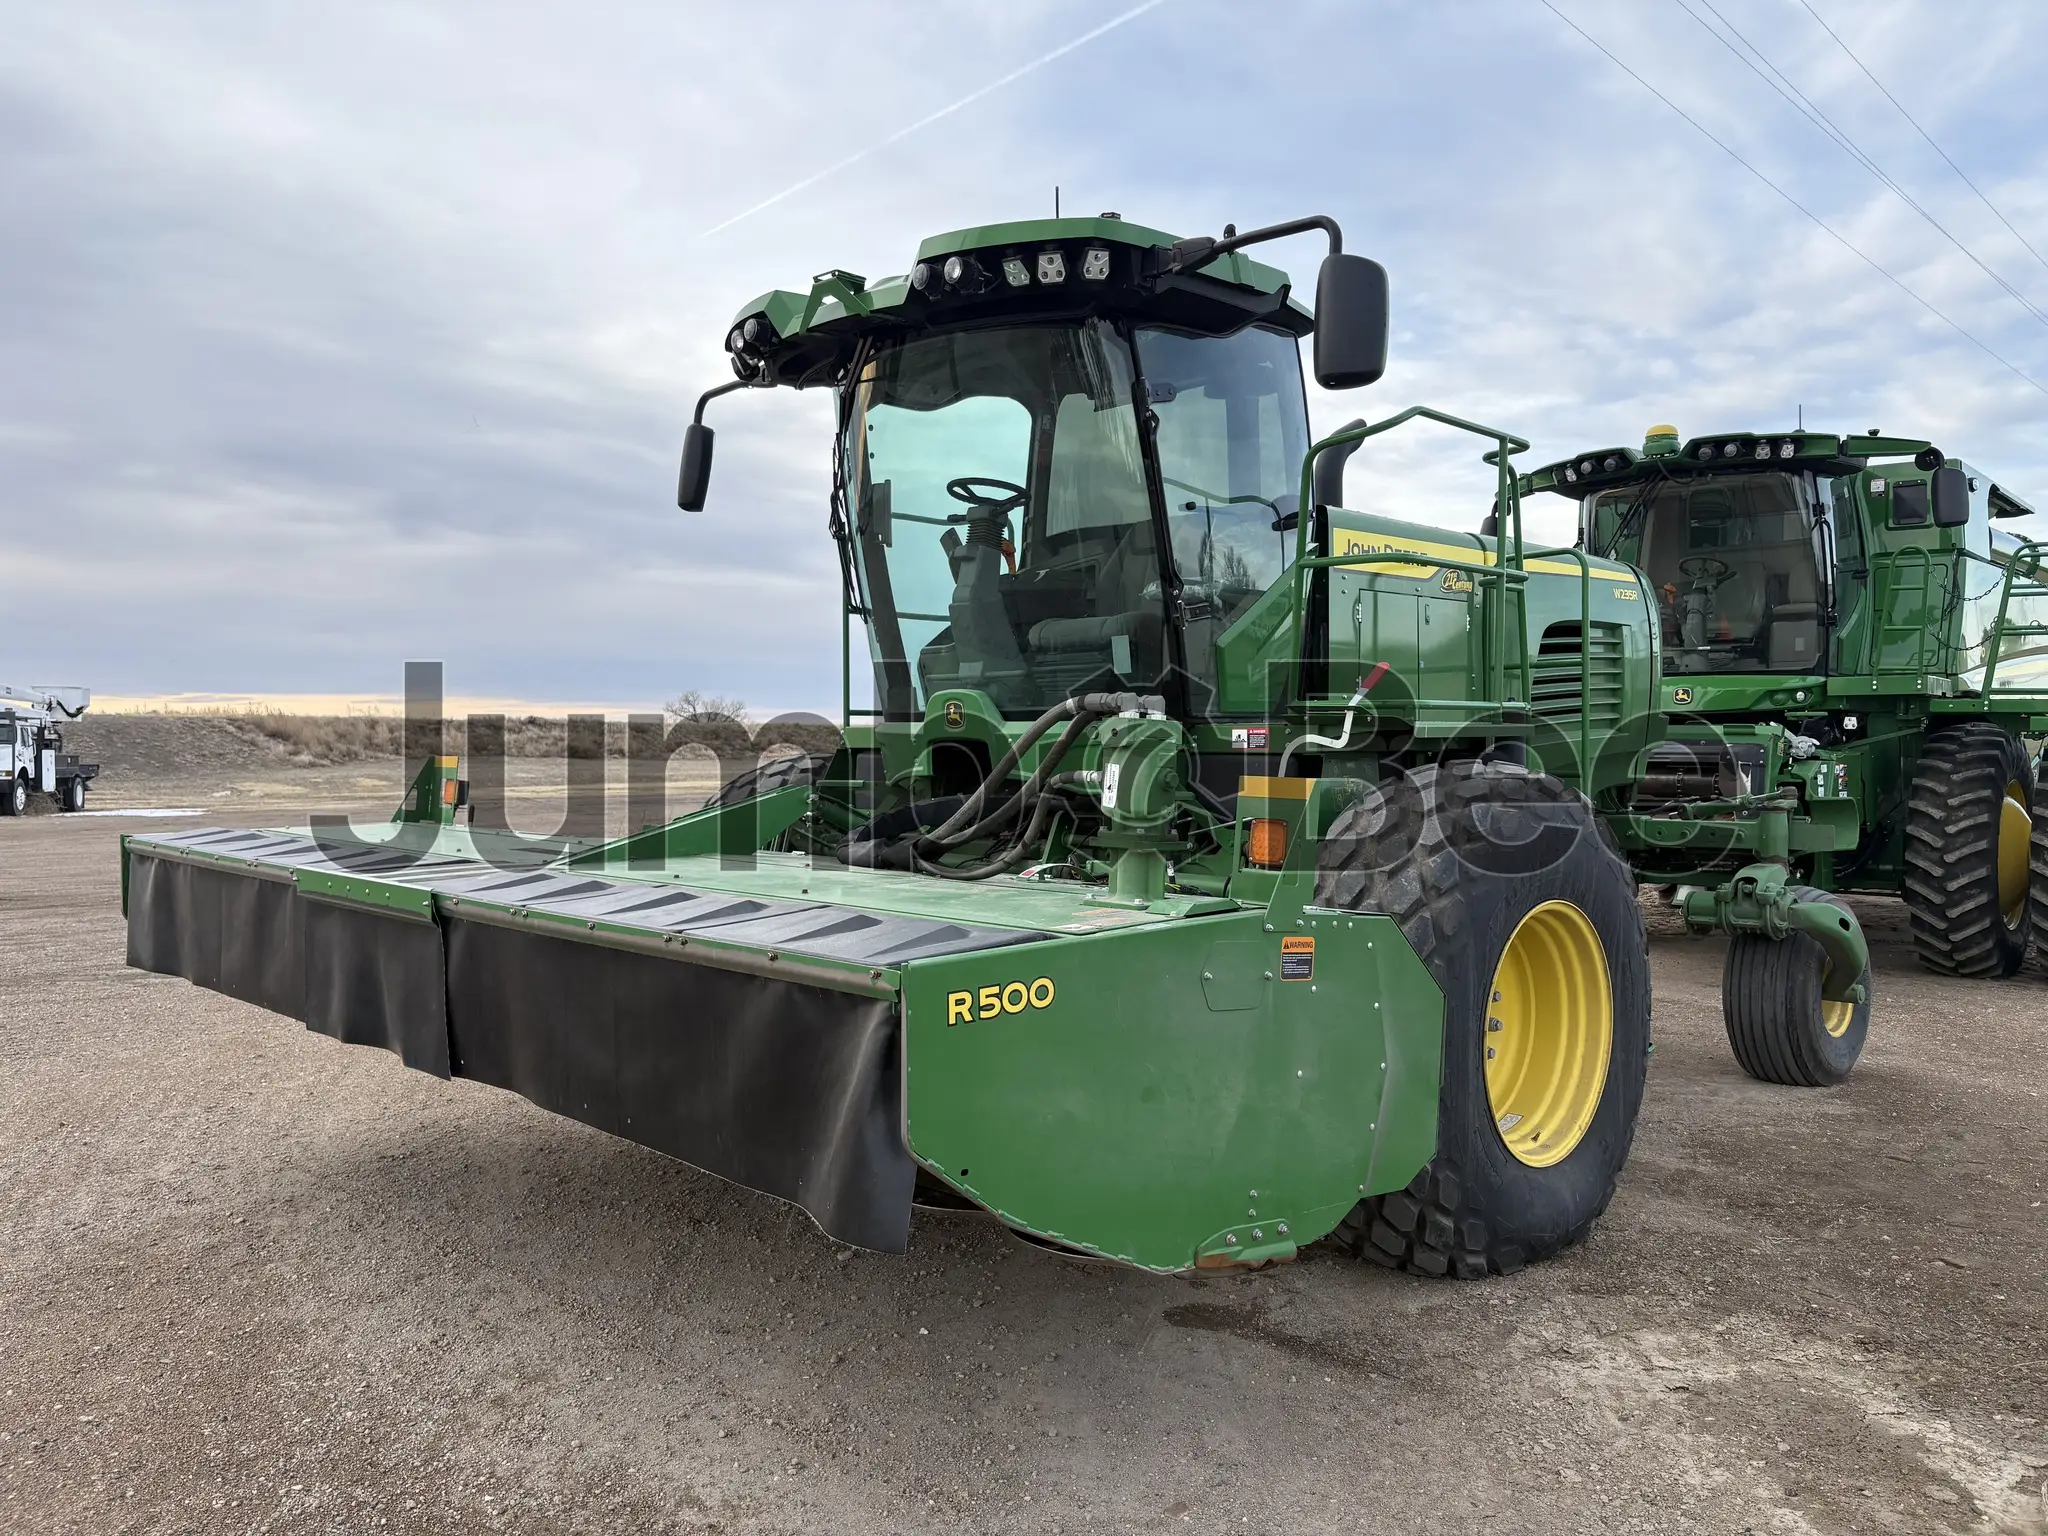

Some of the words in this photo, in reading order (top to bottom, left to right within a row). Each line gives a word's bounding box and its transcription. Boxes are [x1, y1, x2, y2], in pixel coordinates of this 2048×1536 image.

[1343, 539, 1381, 557] JOHN
[1612, 588, 1639, 601] W235R
[1290, 941, 1314, 949] WARNING
